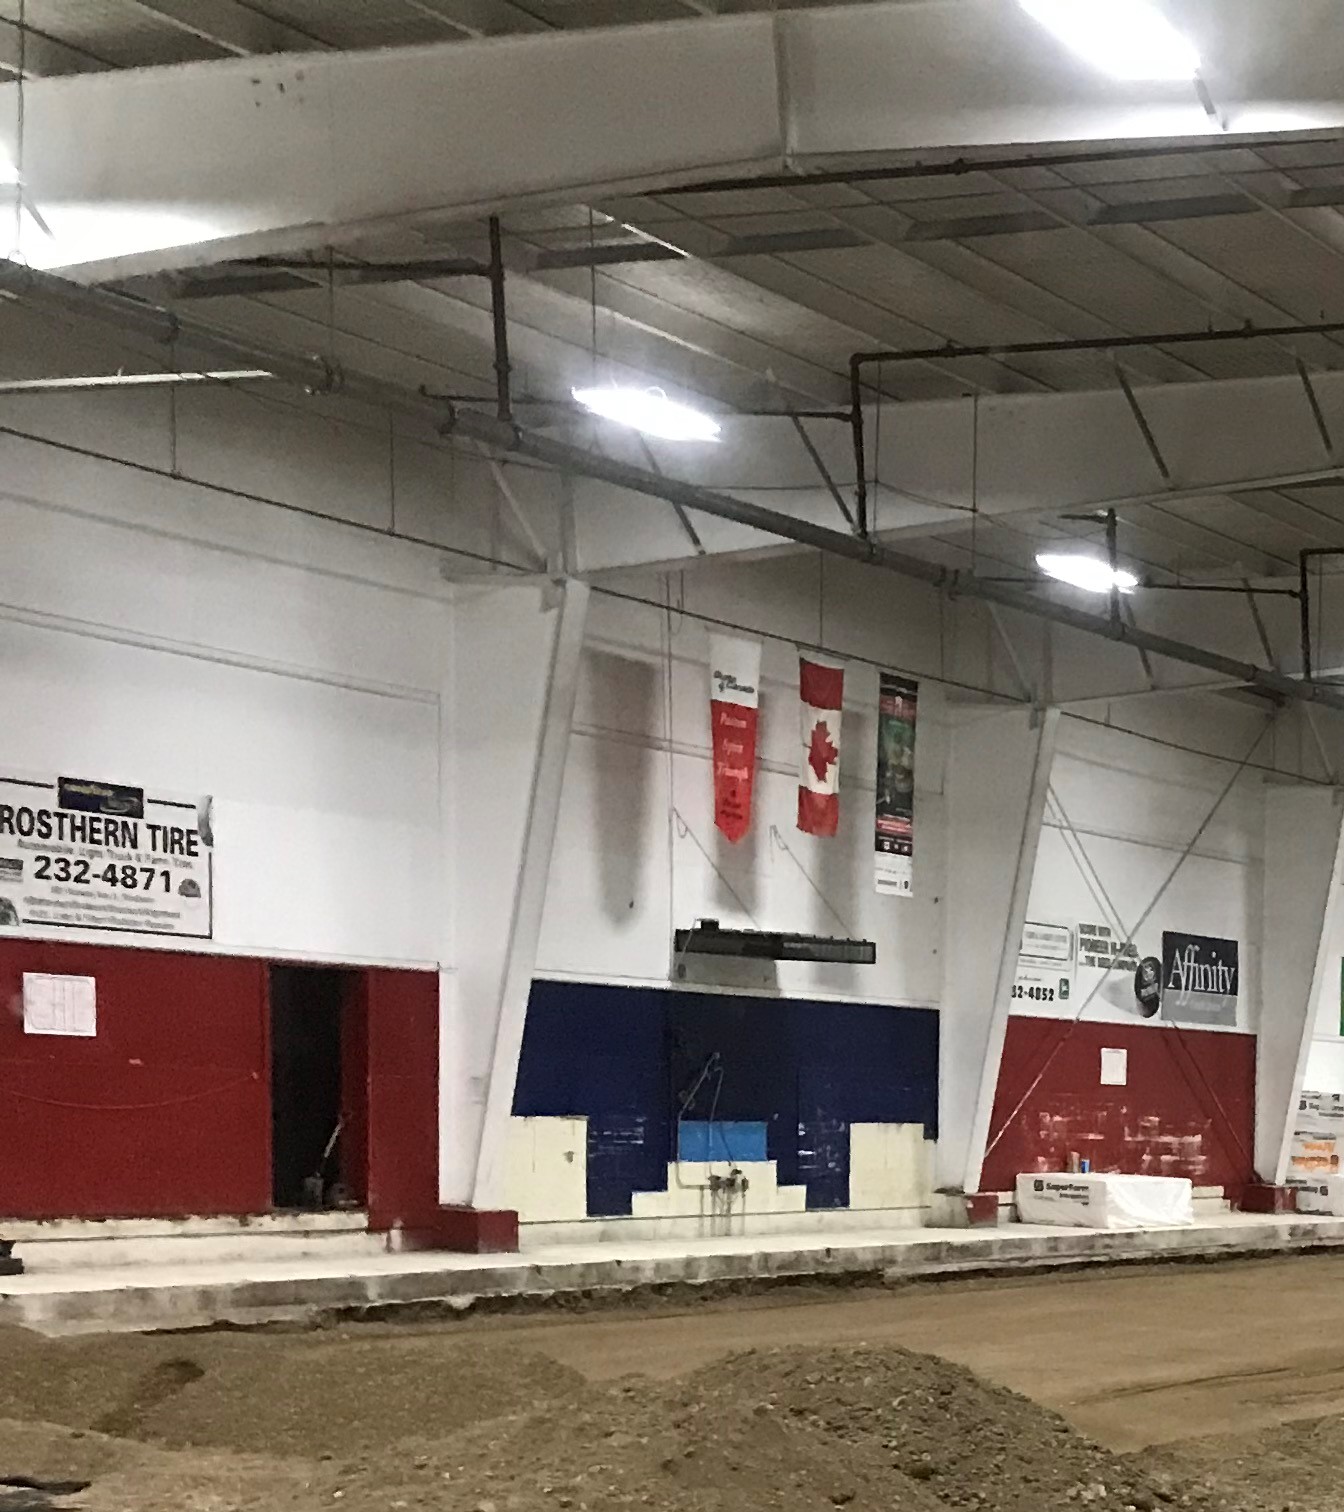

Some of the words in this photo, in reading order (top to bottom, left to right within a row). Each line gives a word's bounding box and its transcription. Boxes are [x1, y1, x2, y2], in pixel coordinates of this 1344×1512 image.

[0, 804, 139, 850] ROSTHERN
[146, 823, 199, 857] TIRE
[34, 855, 171, 893] 232-4871
[1168, 944, 1236, 1007] Affinity
